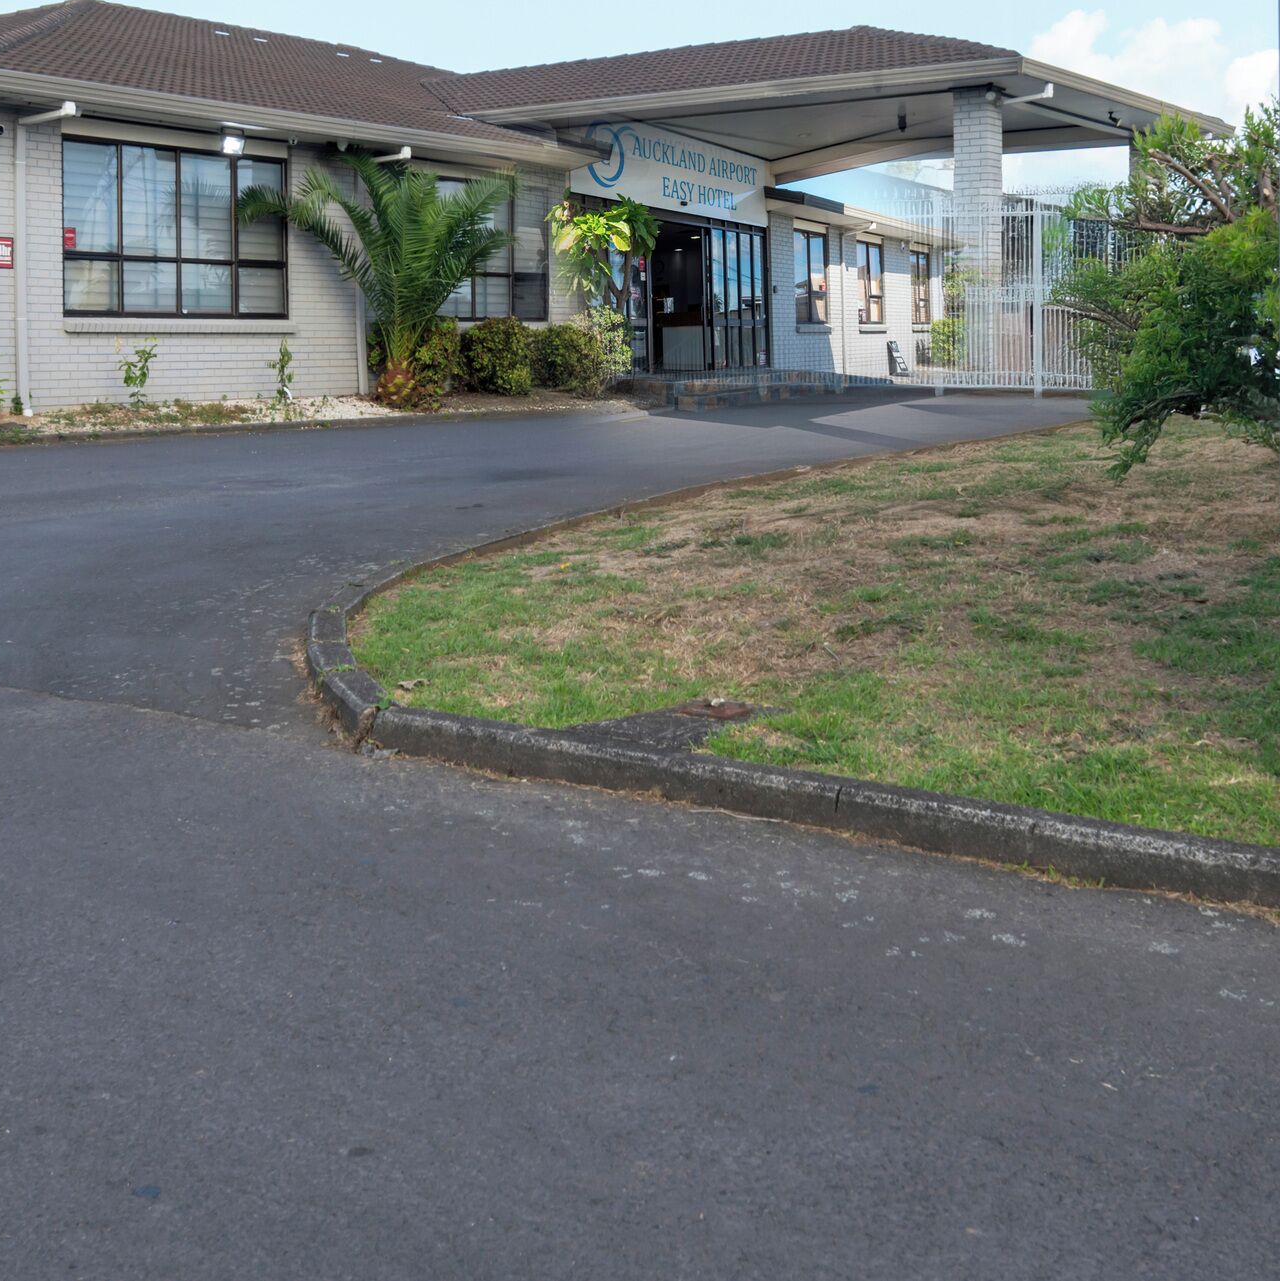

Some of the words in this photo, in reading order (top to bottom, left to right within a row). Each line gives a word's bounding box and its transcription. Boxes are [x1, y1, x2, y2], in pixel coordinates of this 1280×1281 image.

[632, 135, 706, 173] AUCKLAND
[709, 157, 758, 186] AIRPORT
[662, 176, 695, 202] EASY
[698, 184, 737, 211] HOTEL
